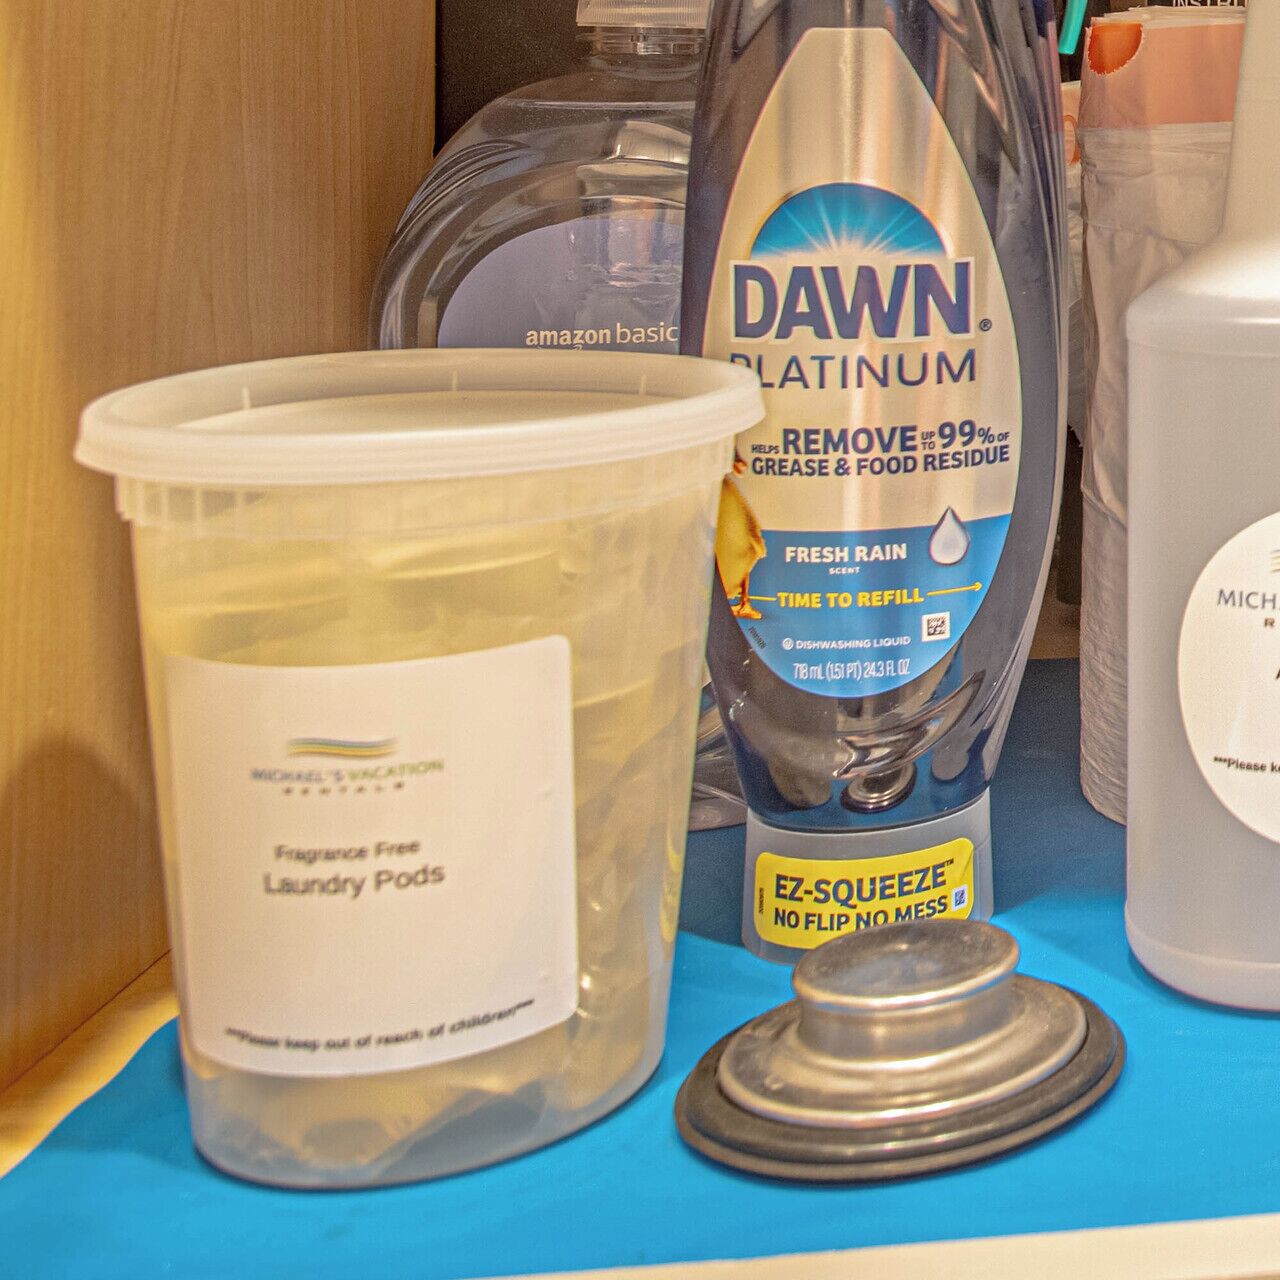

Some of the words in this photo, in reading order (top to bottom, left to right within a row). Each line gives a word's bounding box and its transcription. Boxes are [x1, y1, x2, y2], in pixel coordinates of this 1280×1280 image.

[525, 327, 611, 346] amazon
[782, 424, 918, 455] REMOVE
[921, 431, 936, 441] UP
[938, 419, 995, 450] 99%
[997, 431, 1011, 442] OF
[751, 444, 779, 455] HELPS
[921, 440, 936, 451] TO
[752, 457, 830, 477] GREASE
[834, 457, 851, 476] &
[856, 455, 917, 477] FOOD
[923, 445, 1011, 472] RESIDUE
[785, 545, 850, 564] FRESH
[854, 543, 908, 563] RAIN
[828, 566, 860, 575] SCENT
[777, 591, 822, 609] TIME
[825, 591, 853, 608] TO
[857, 588, 925, 608] REFILL
[795, 639, 871, 651] DISHWASHING
[873, 636, 911, 648] LIQUID
[349, 758, 446, 781] VACATION
[273, 843, 369, 867] Fragrance
[374, 840, 421, 859] Free
[262, 871, 368, 900] Laundry
[374, 864, 447, 892] Pods
[774, 907, 800, 928] NO
[804, 911, 850, 931] FLIP
[856, 909, 889, 928] NO
[895, 894, 948, 922] MESS
[284, 1036, 321, 1053] keep
[324, 1037, 351, 1050] out
[355, 1034, 373, 1049] of
[376, 1028, 424, 1048] reach
[428, 1023, 446, 1038] of
